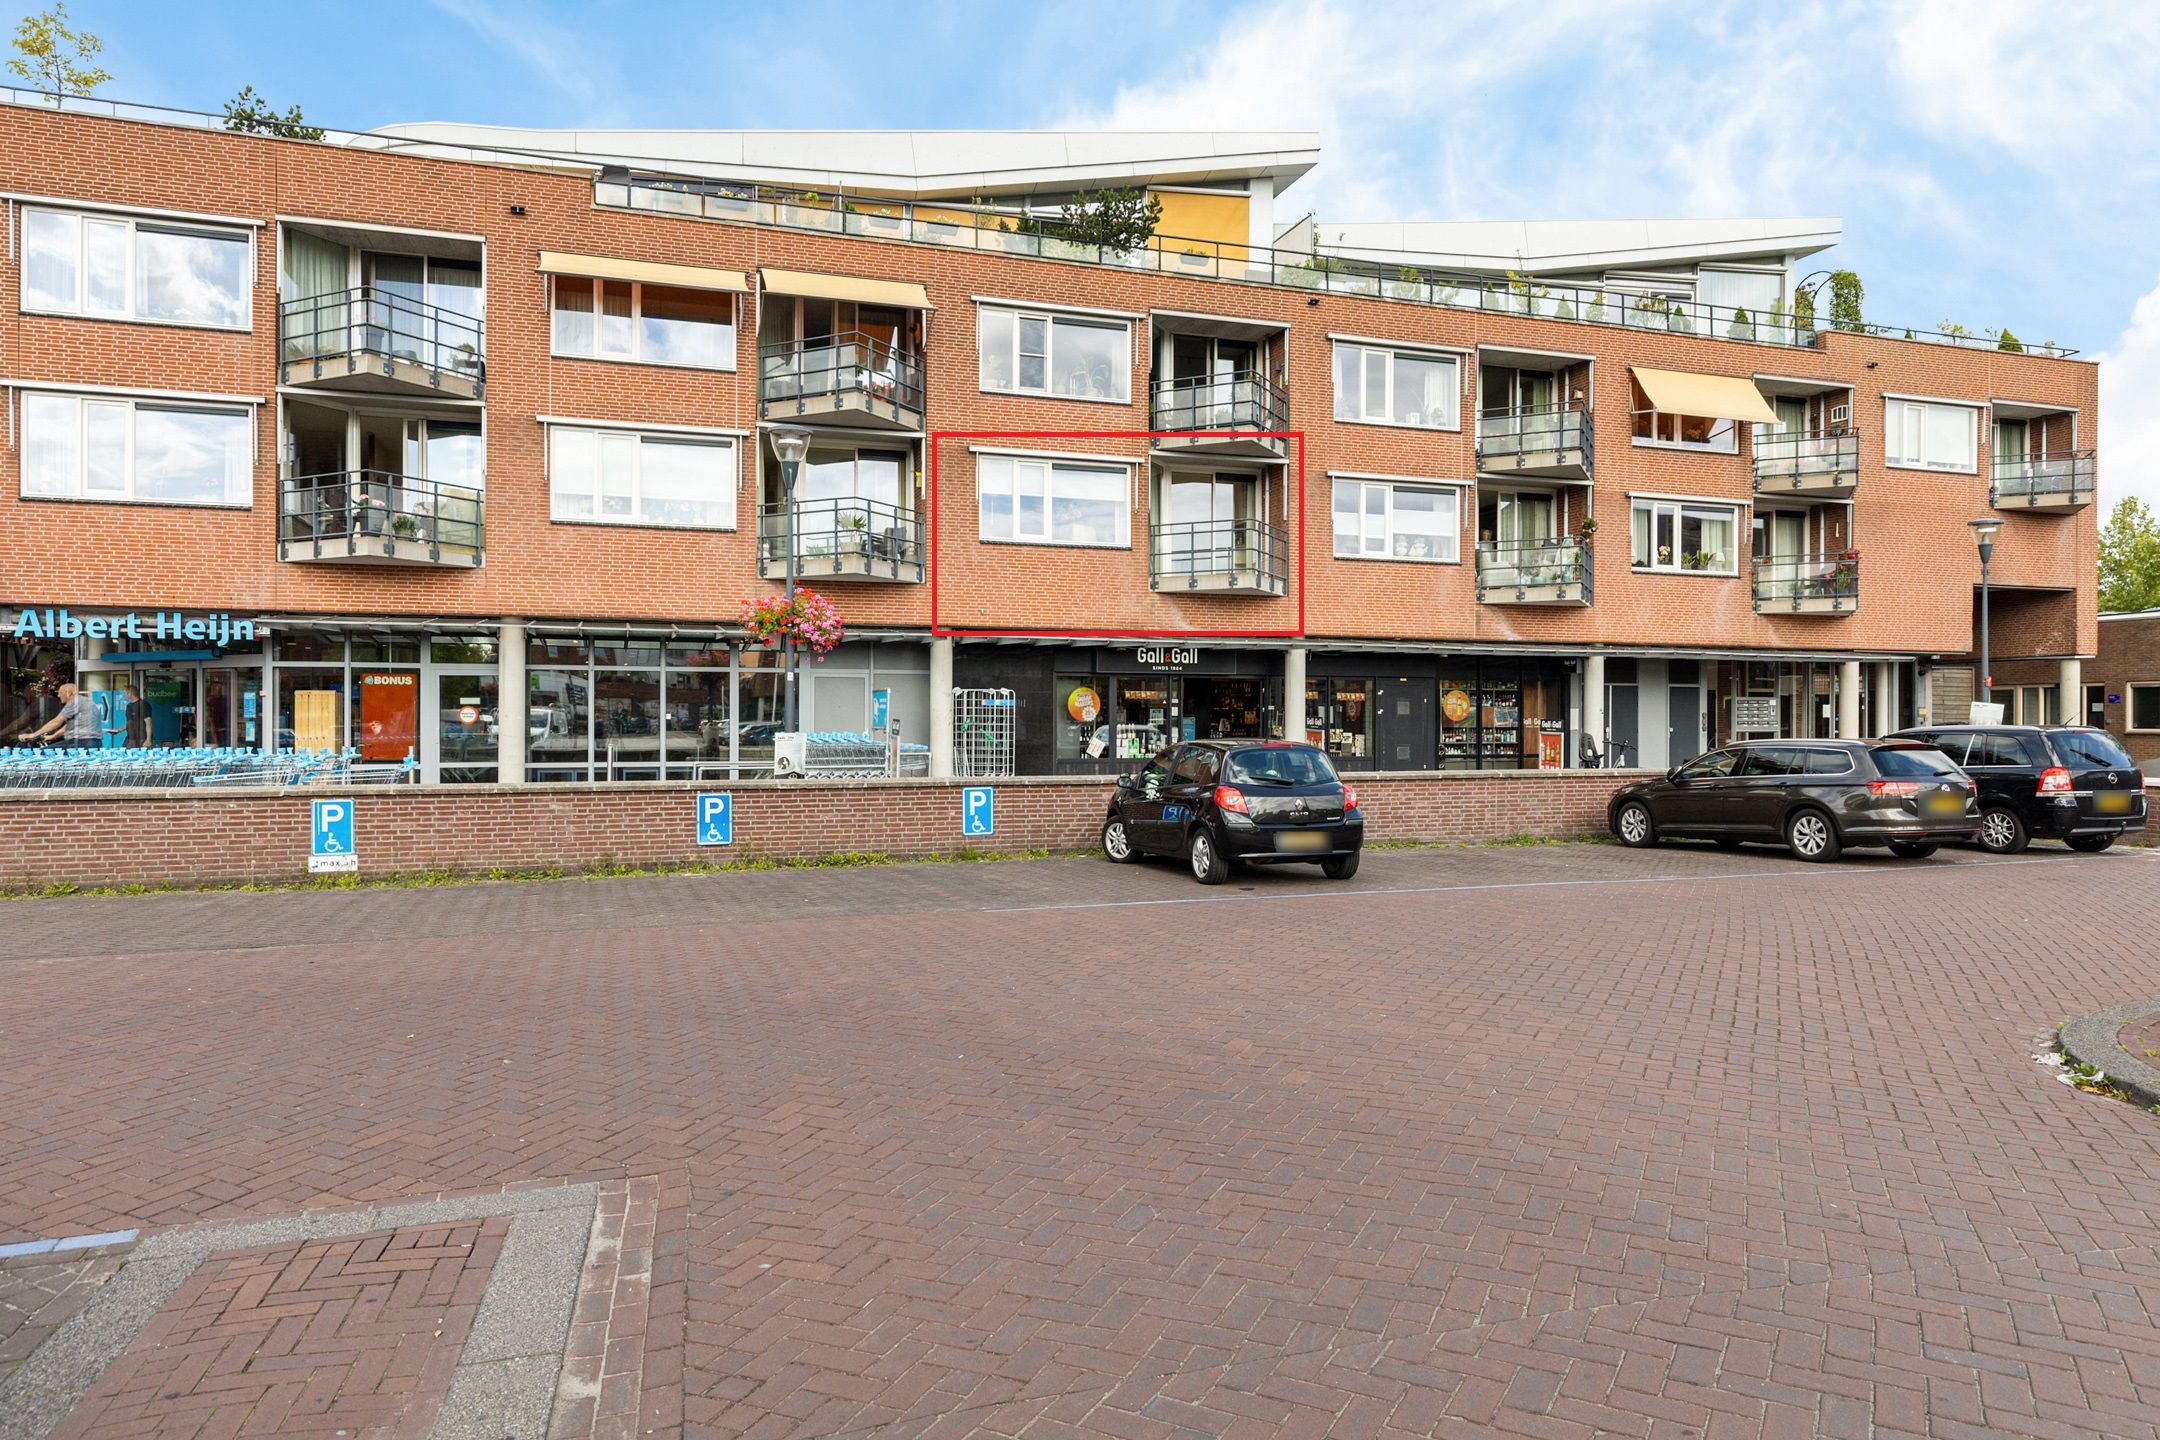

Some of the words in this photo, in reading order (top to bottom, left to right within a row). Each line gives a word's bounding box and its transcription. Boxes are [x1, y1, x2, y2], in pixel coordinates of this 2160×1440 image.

[13, 609, 142, 639] Albert
[157, 612, 254, 647] Heijn
[373, 676, 413, 685] BONUS
[704, 798, 724, 823] P
[970, 791, 987, 816] P
[321, 804, 345, 833] P
